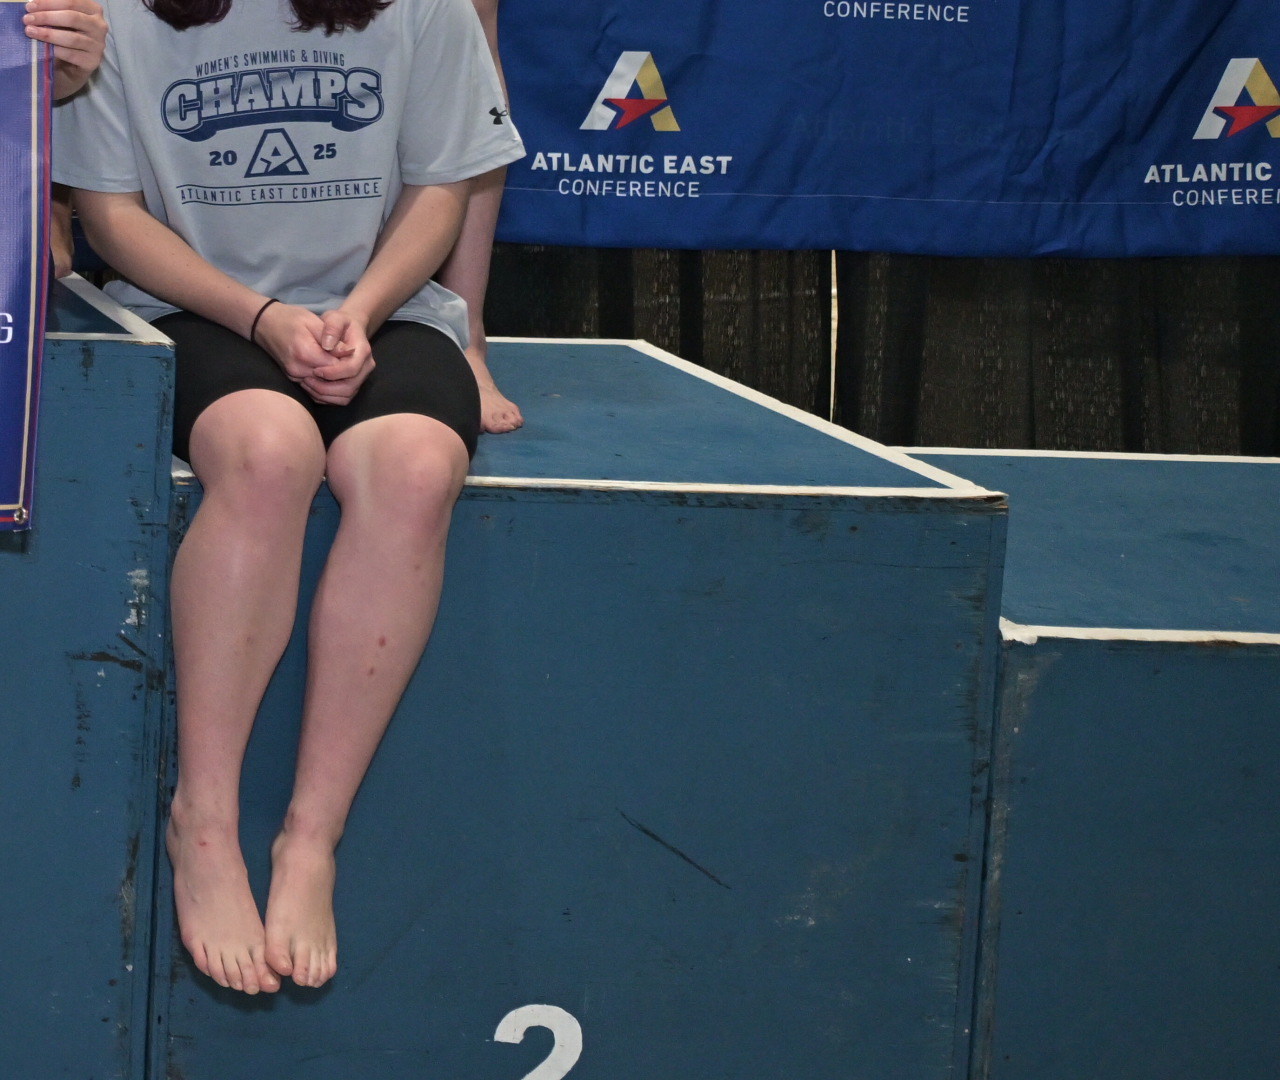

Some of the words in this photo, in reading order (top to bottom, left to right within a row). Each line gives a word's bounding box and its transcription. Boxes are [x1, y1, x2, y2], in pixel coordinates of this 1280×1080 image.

[824, 1, 969, 22] CONFERENCE
[195, 56, 239, 77] WOMEN'S
[243, 50, 295, 67] SWIMMING
[301, 49, 308, 62] &
[313, 50, 345, 67] DIVING
[160, 65, 384, 138] CHAMPS
[208, 149, 237, 167] 20
[312, 142, 337, 160] 25
[531, 152, 653, 173] ATLANTIC
[664, 156, 732, 174] EAST
[1144, 162, 1272, 183] ATLANTIC
[180, 186, 241, 203] ATLANTIC
[250, 187, 283, 201] EAST
[292, 181, 379, 199] CONFERENCE
[559, 179, 699, 197] CONFERENCE
[494, 1004, 582, 1080] 2
